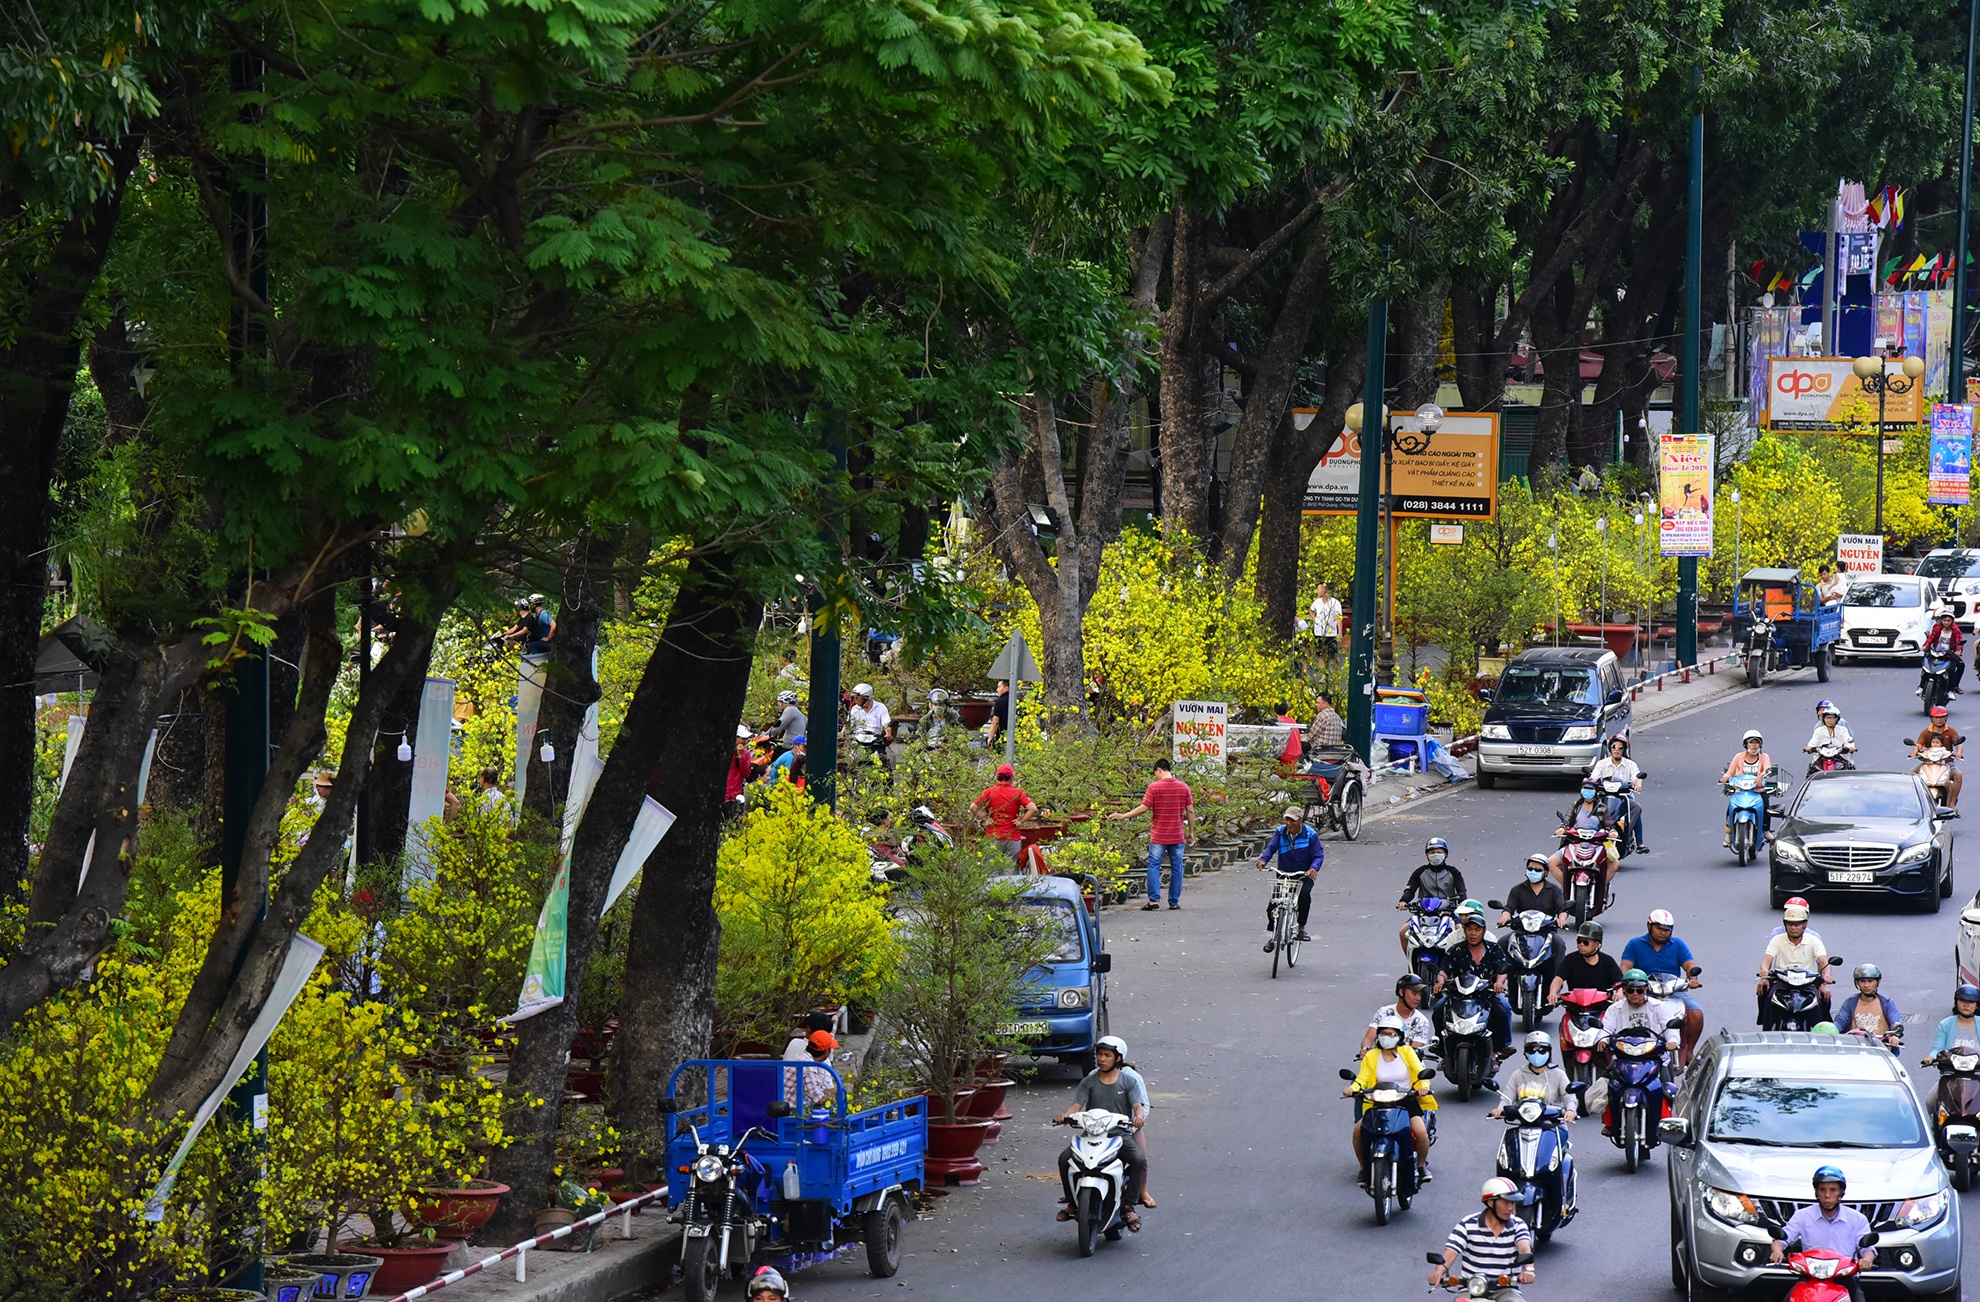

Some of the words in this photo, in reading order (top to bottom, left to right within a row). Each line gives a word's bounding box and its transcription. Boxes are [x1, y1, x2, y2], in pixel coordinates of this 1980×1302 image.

[1668, 452, 1702, 462] Xiếc
[1403, 500, 1428, 510] (028)
[1430, 501, 1456, 510] 3844
[1460, 502, 1484, 511] 1111
[1842, 536, 1862, 544] VƯỜN
[1840, 545, 1879, 559] NGUYỄN
[1179, 703, 1204, 713] VƯỜN
[1207, 706, 1223, 714] MAI
[1176, 716, 1224, 737] NGUYỄN
[1179, 742, 1220, 758] QUANG
